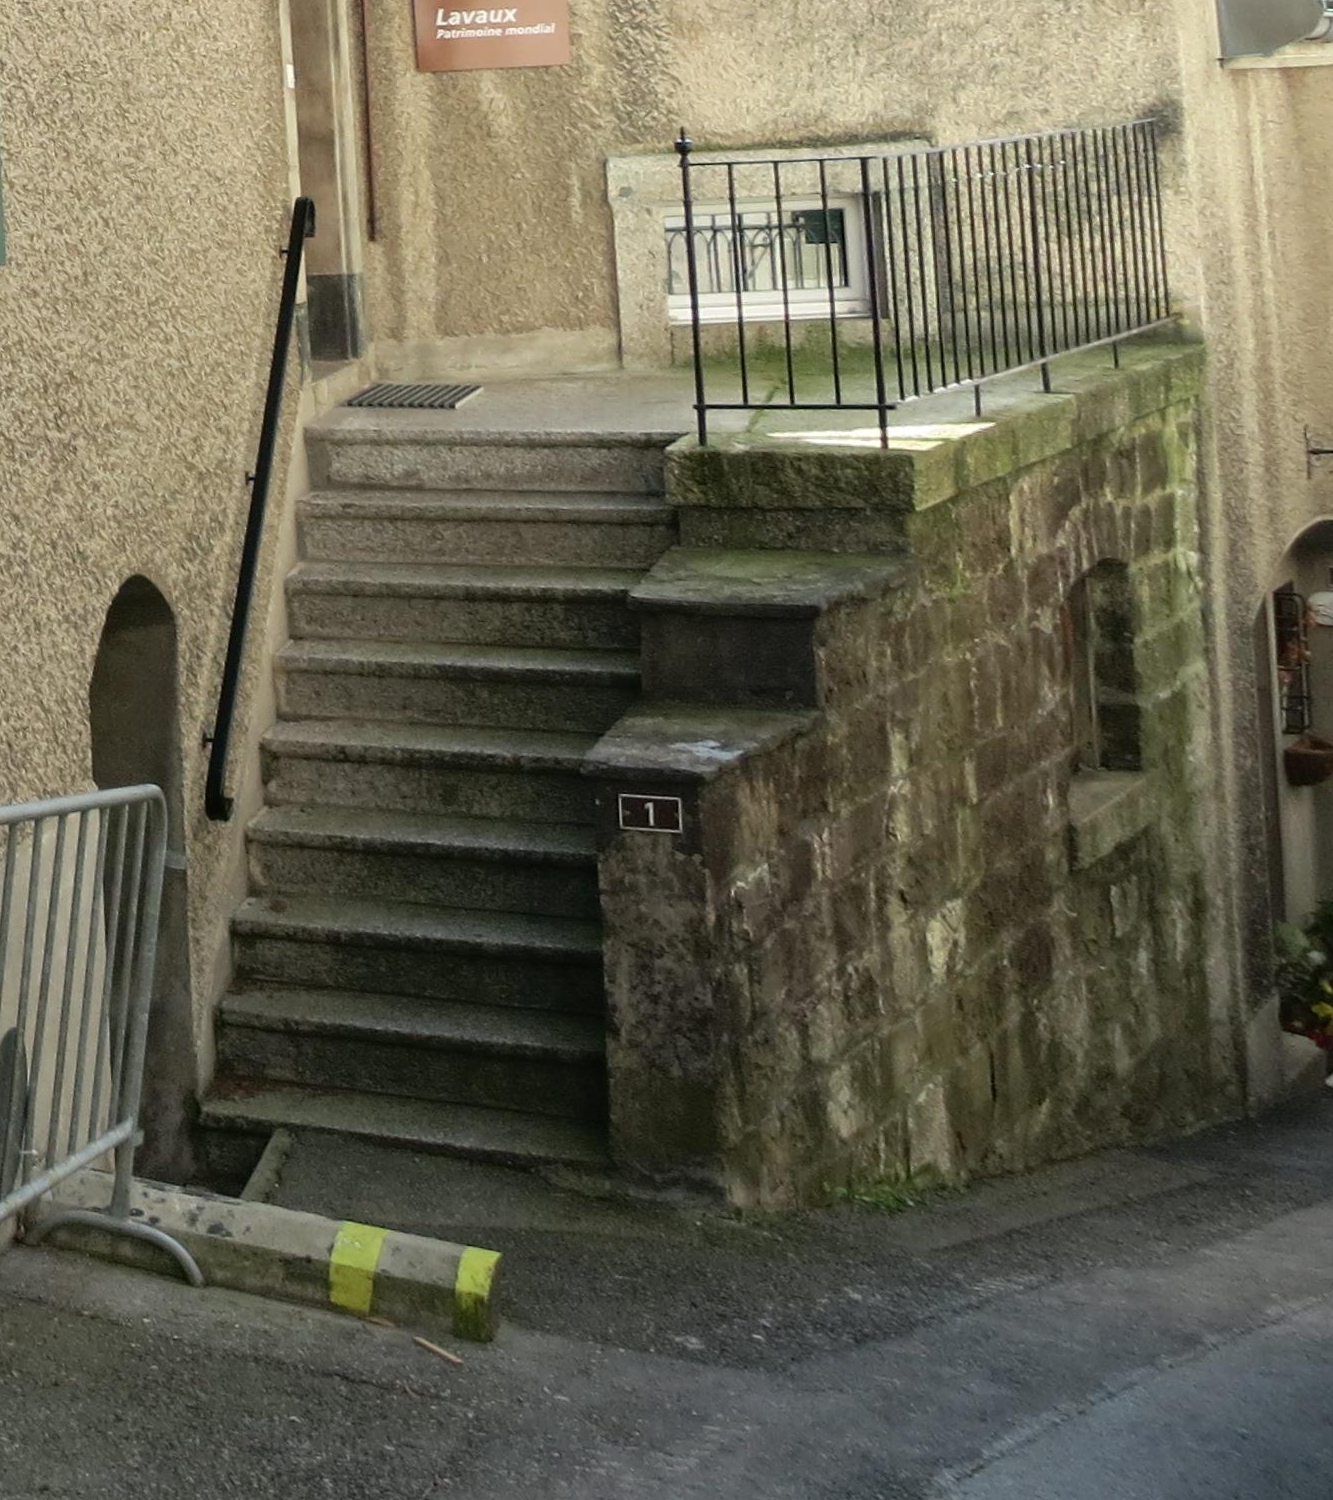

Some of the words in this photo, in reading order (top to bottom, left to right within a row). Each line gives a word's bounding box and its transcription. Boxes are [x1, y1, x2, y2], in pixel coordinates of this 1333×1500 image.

[436, 8, 518, 26] Lavaux
[436, 26, 503, 39] Patrimoine
[506, 23, 555, 35] mondial
[644, 802, 655, 826] 1
